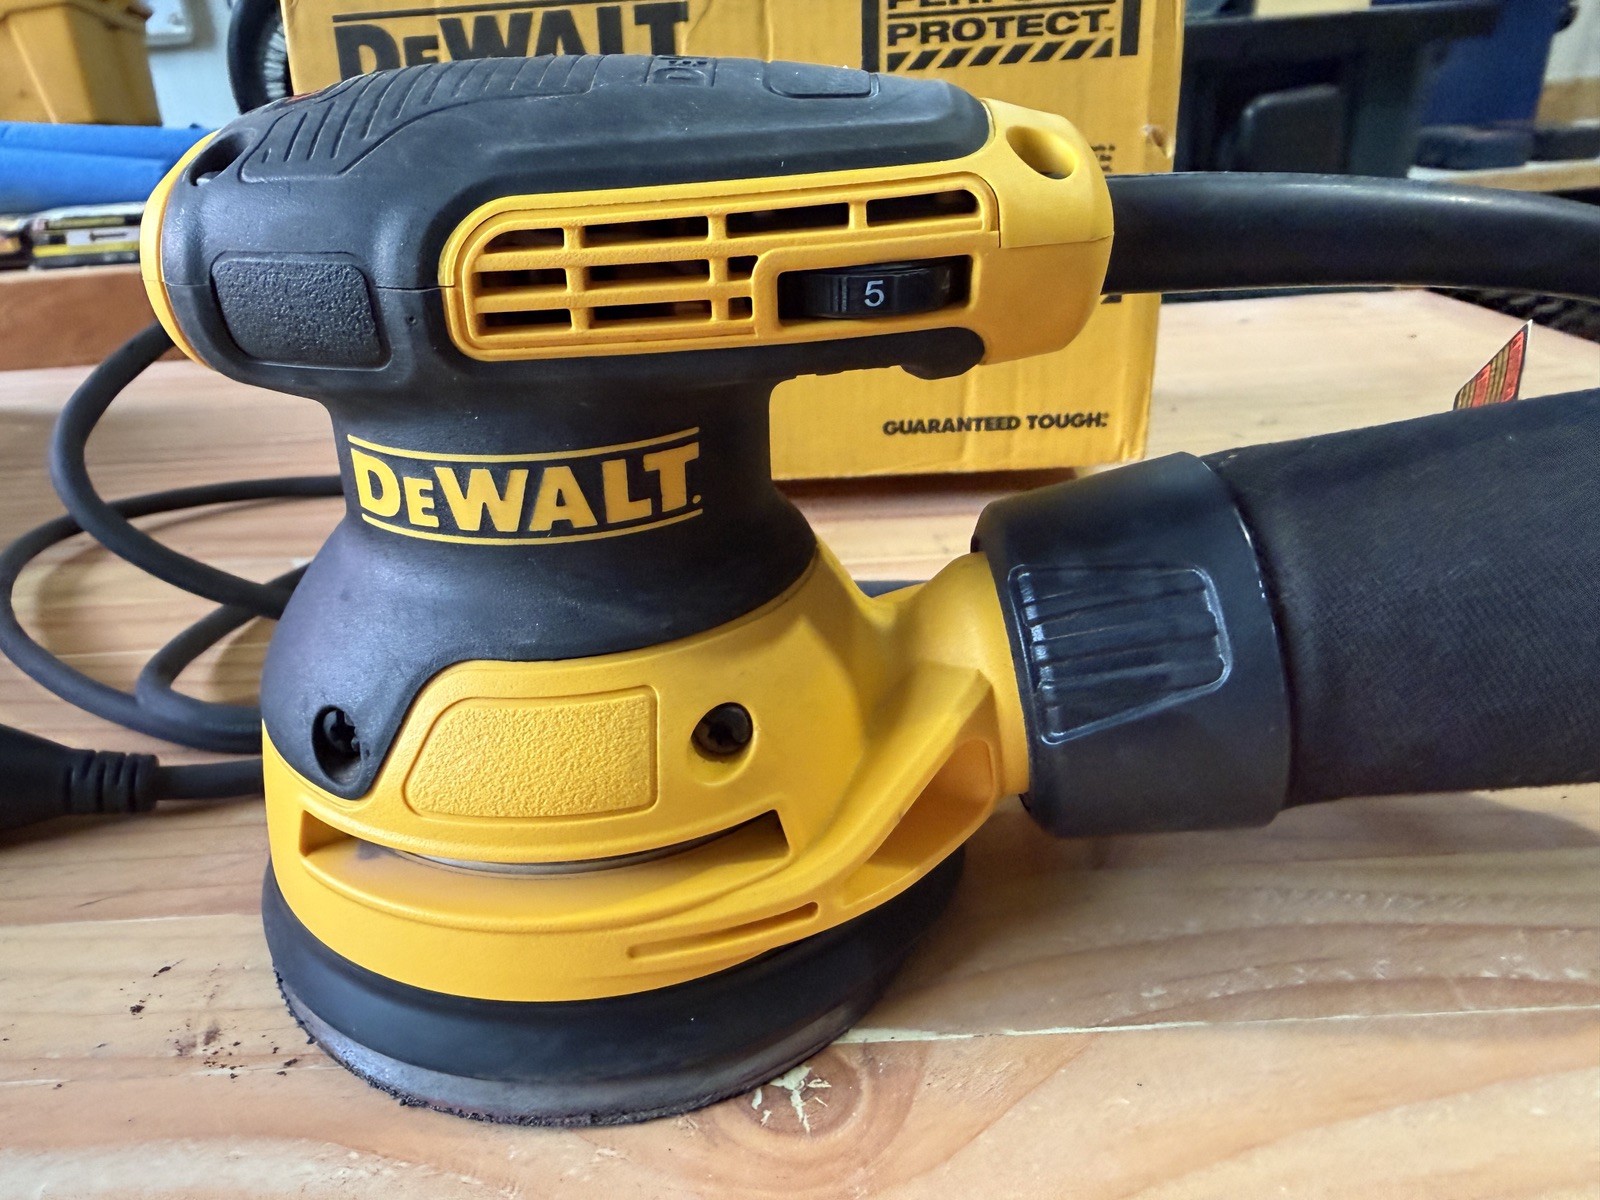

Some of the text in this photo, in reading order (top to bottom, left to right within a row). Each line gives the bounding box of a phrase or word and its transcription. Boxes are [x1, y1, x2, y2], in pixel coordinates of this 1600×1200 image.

[887, 9, 1110, 46] PROTECT
[864, 279, 885, 307] 5
[882, 415, 1021, 436] GUARANTEED
